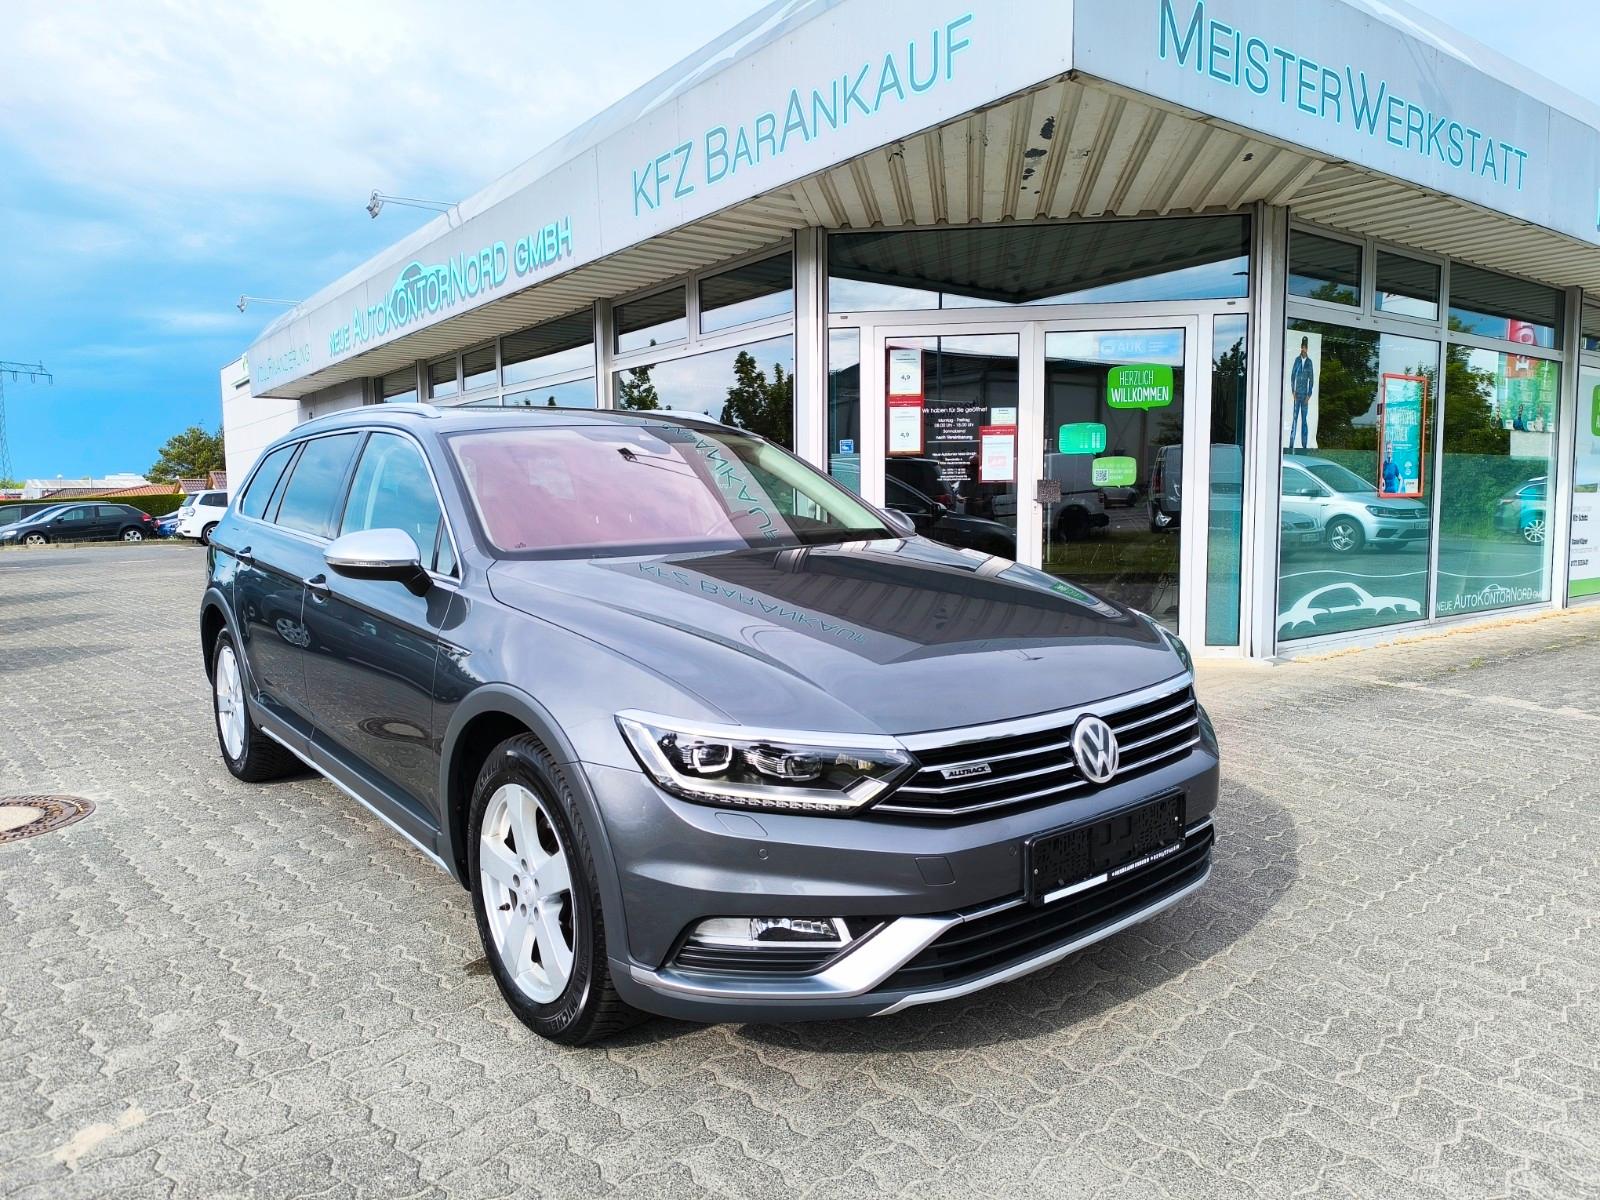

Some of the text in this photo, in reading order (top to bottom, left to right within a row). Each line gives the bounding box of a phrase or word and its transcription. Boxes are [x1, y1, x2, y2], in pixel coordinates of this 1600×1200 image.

[631, 141, 695, 216] KFZ
[329, 323, 351, 357] NEUE
[1119, 370, 1154, 386] HERZLICH
[1111, 386, 1169, 402] WILLKOMMEN
[948, 766, 988, 778] ALLTRACK
